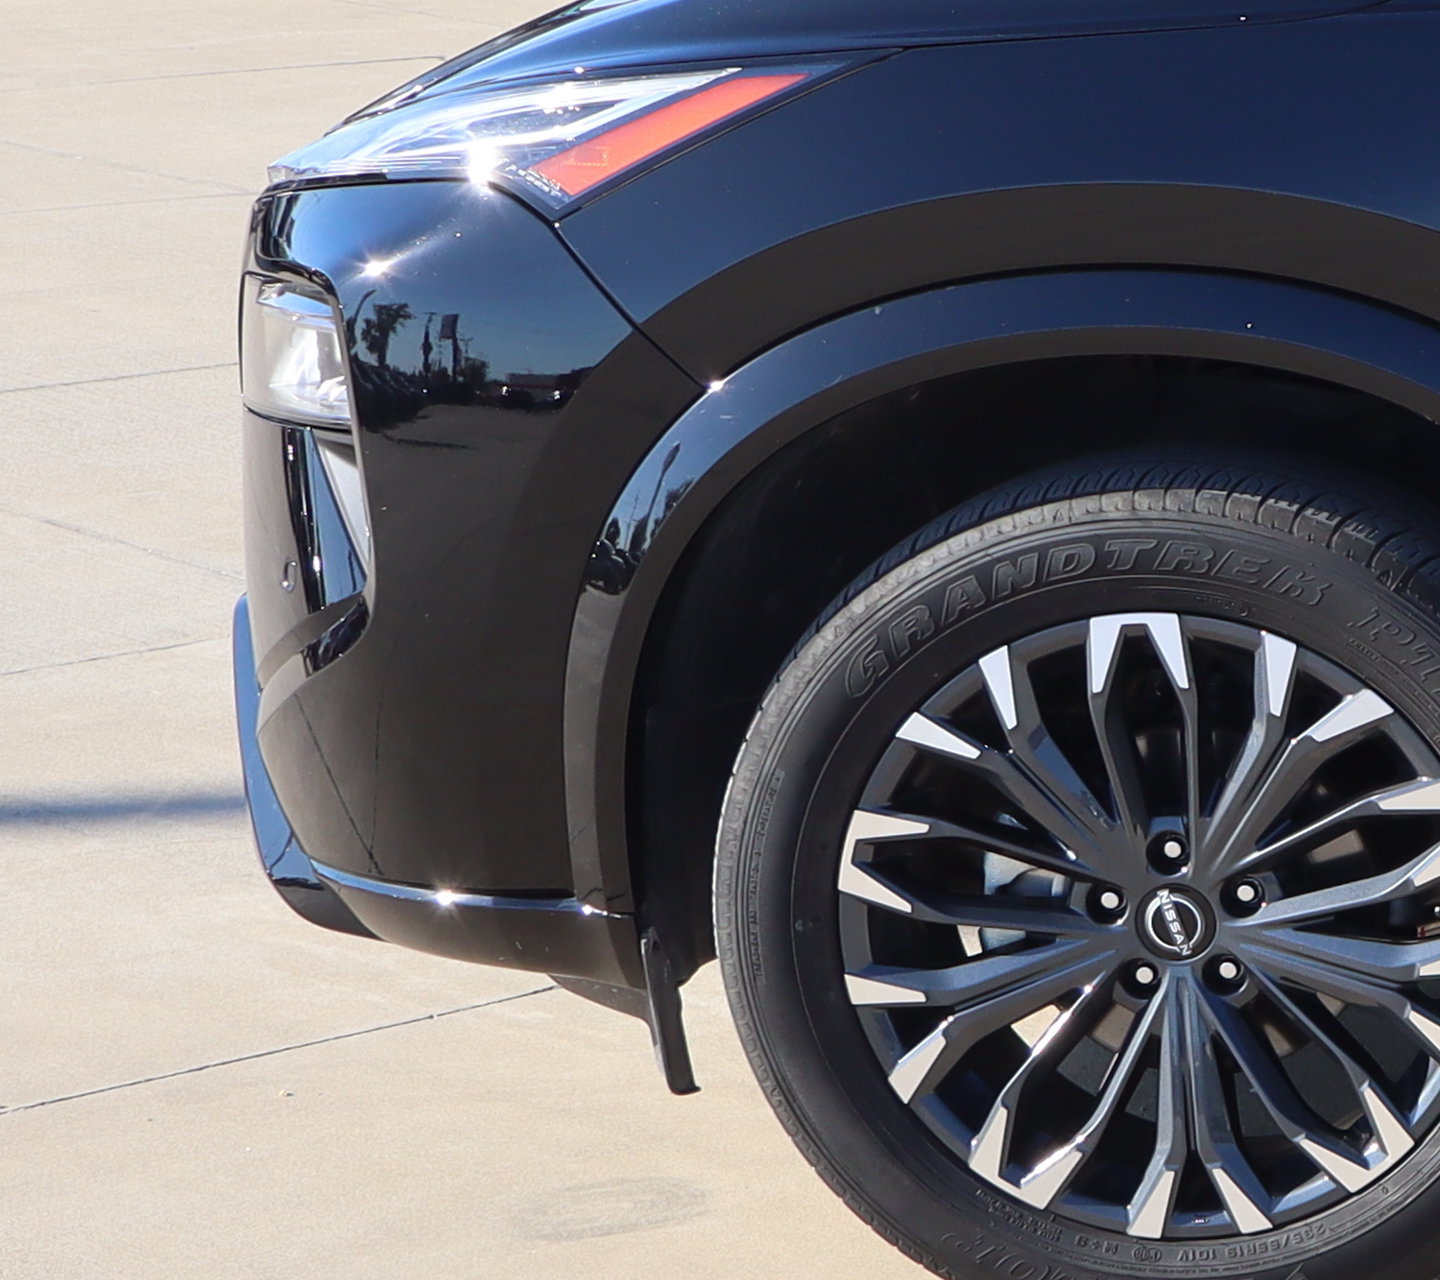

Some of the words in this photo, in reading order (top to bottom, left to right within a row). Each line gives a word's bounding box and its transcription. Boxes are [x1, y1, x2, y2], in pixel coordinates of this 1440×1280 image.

[845, 538, 1333, 697] GRANDTREK
[1157, 888, 1192, 956] NISSAN
[1176, 1247, 1219, 1264] 101V
